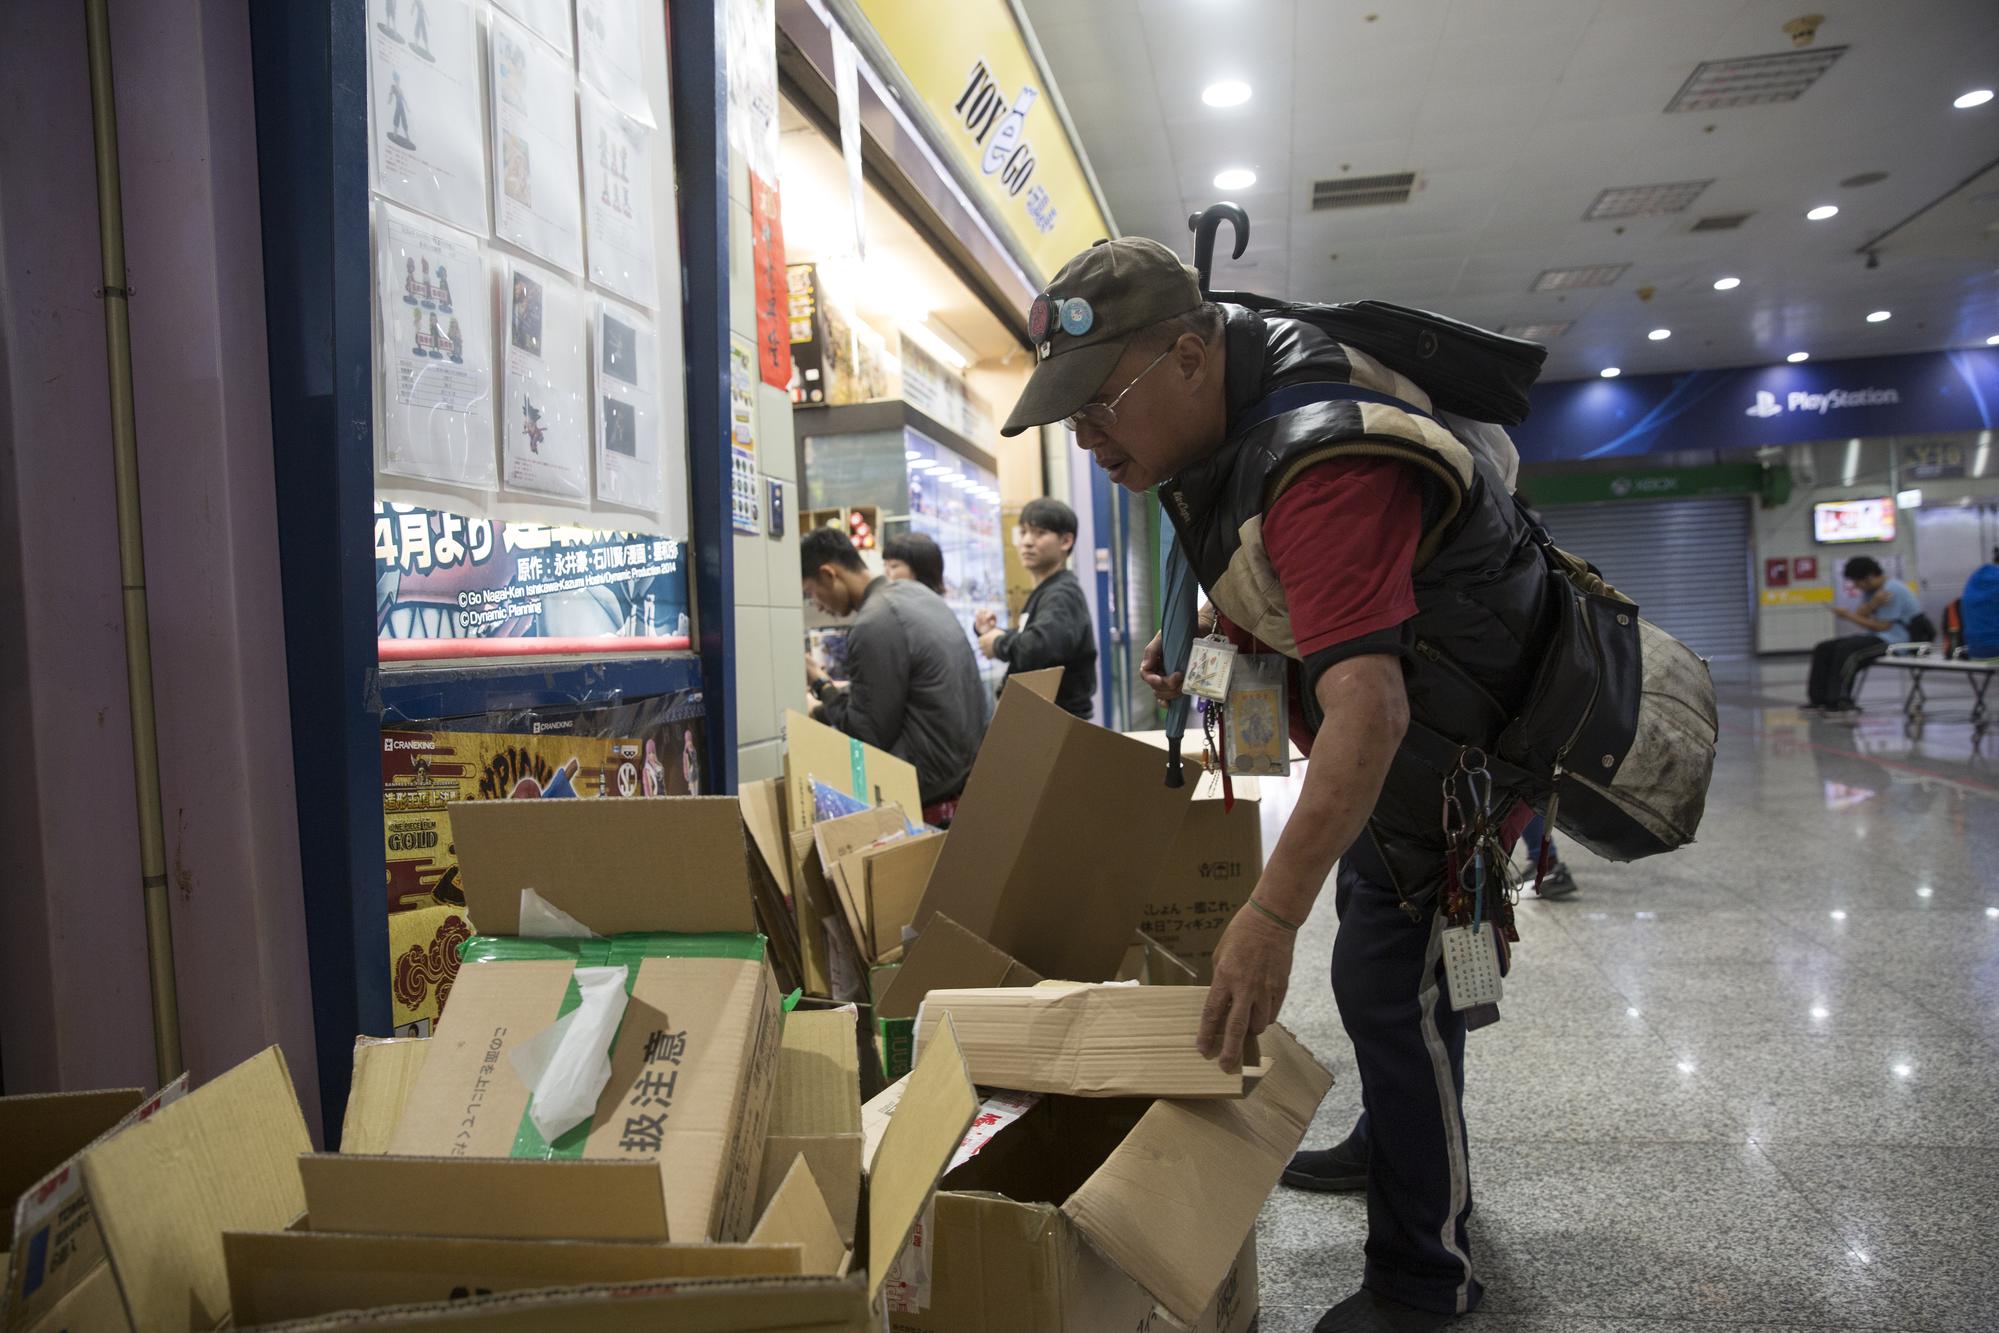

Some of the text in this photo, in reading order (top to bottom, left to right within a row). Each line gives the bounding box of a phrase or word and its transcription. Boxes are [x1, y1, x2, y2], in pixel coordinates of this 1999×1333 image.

[955, 61, 1035, 196] TOY GO
[1787, 386, 1899, 414] PlayStation
[508, 601, 542, 619] Planning
[393, 740, 436, 750] CRANEKING
[388, 831, 439, 851] GOLD
[619, 1029, 688, 1158] 扱注意
